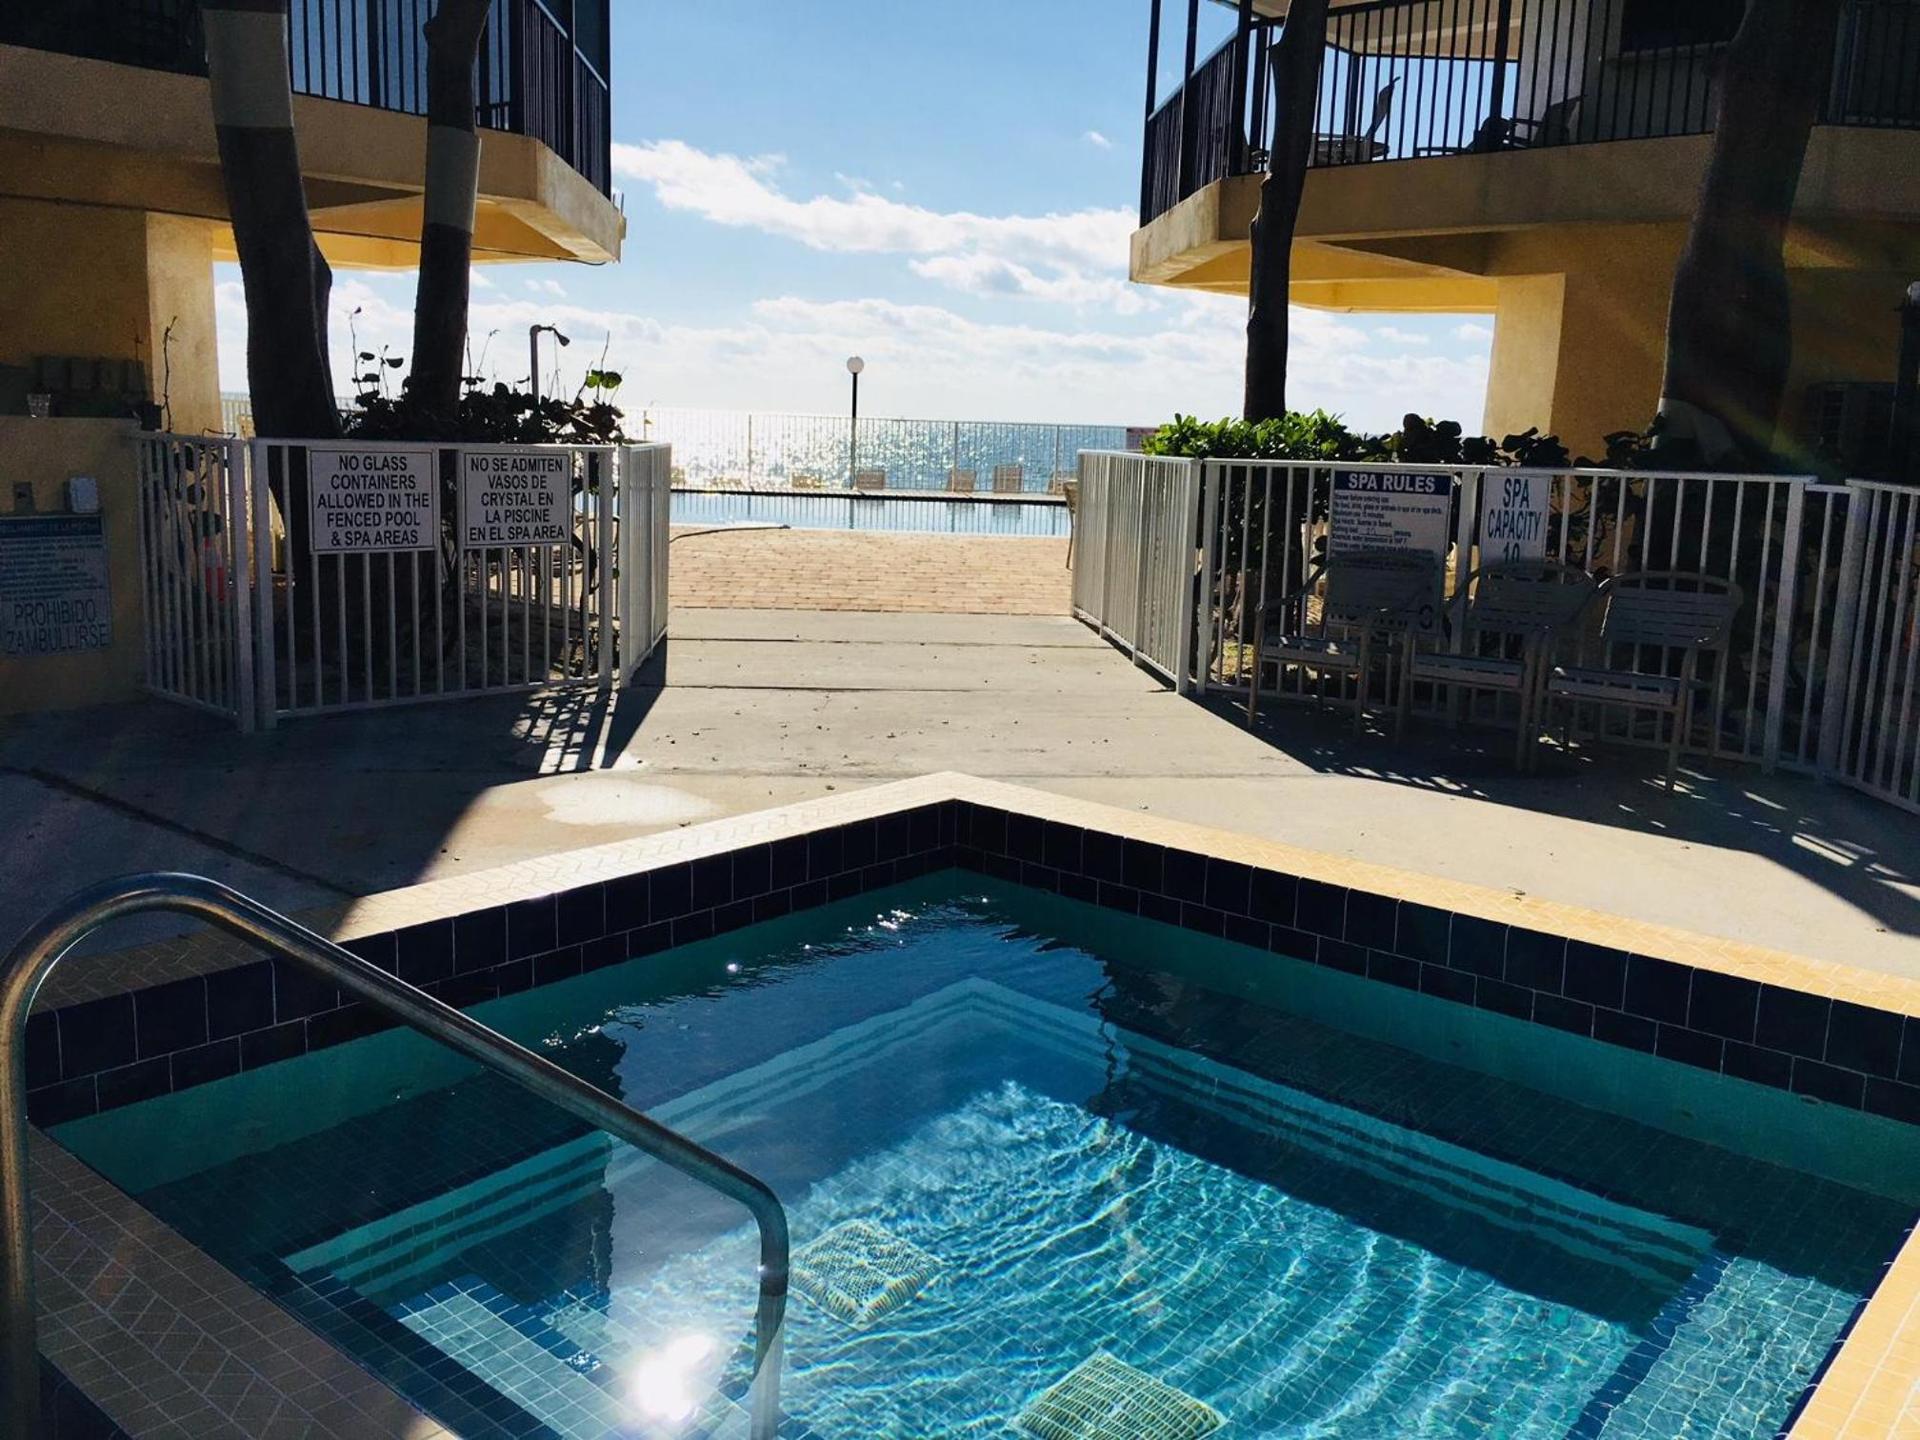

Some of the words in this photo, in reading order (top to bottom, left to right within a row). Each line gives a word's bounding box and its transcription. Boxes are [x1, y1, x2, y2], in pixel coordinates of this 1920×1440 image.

[339, 455, 359, 470] NO
[363, 456, 407, 470] GLASS
[470, 457, 489, 471] NO
[492, 458, 508, 471] SE
[511, 458, 563, 471] ADMITEN
[330, 474, 416, 490] CONTAINERS
[488, 475, 528, 490] VASOS
[531, 475, 547, 489] DE
[1347, 472, 1378, 492] SPA
[1382, 474, 1436, 494] RULES
[317, 493, 385, 509] ALLOWED
[388, 493, 401, 508] IN
[404, 493, 429, 508] THE
[481, 492, 535, 507] CRYSTAL
[538, 492, 554, 506] EN
[1502, 478, 1530, 509] SPA
[327, 512, 381, 528] FENCED
[385, 512, 420, 527] POOL
[485, 509, 500, 524] LA
[503, 509, 550, 523] PISCINE
[469, 528, 486, 541] EN
[489, 527, 504, 541] EL
[507, 526, 531, 540] SPA
[533, 525, 565, 539] AREA
[1487, 510, 1542, 541] CAPACITY
[331, 531, 341, 546] &
[344, 531, 370, 546] SPA
[375, 530, 418, 545] AREAS
[1503, 542, 1520, 564] 10
[14, 598, 96, 626] PROHIBIDO
